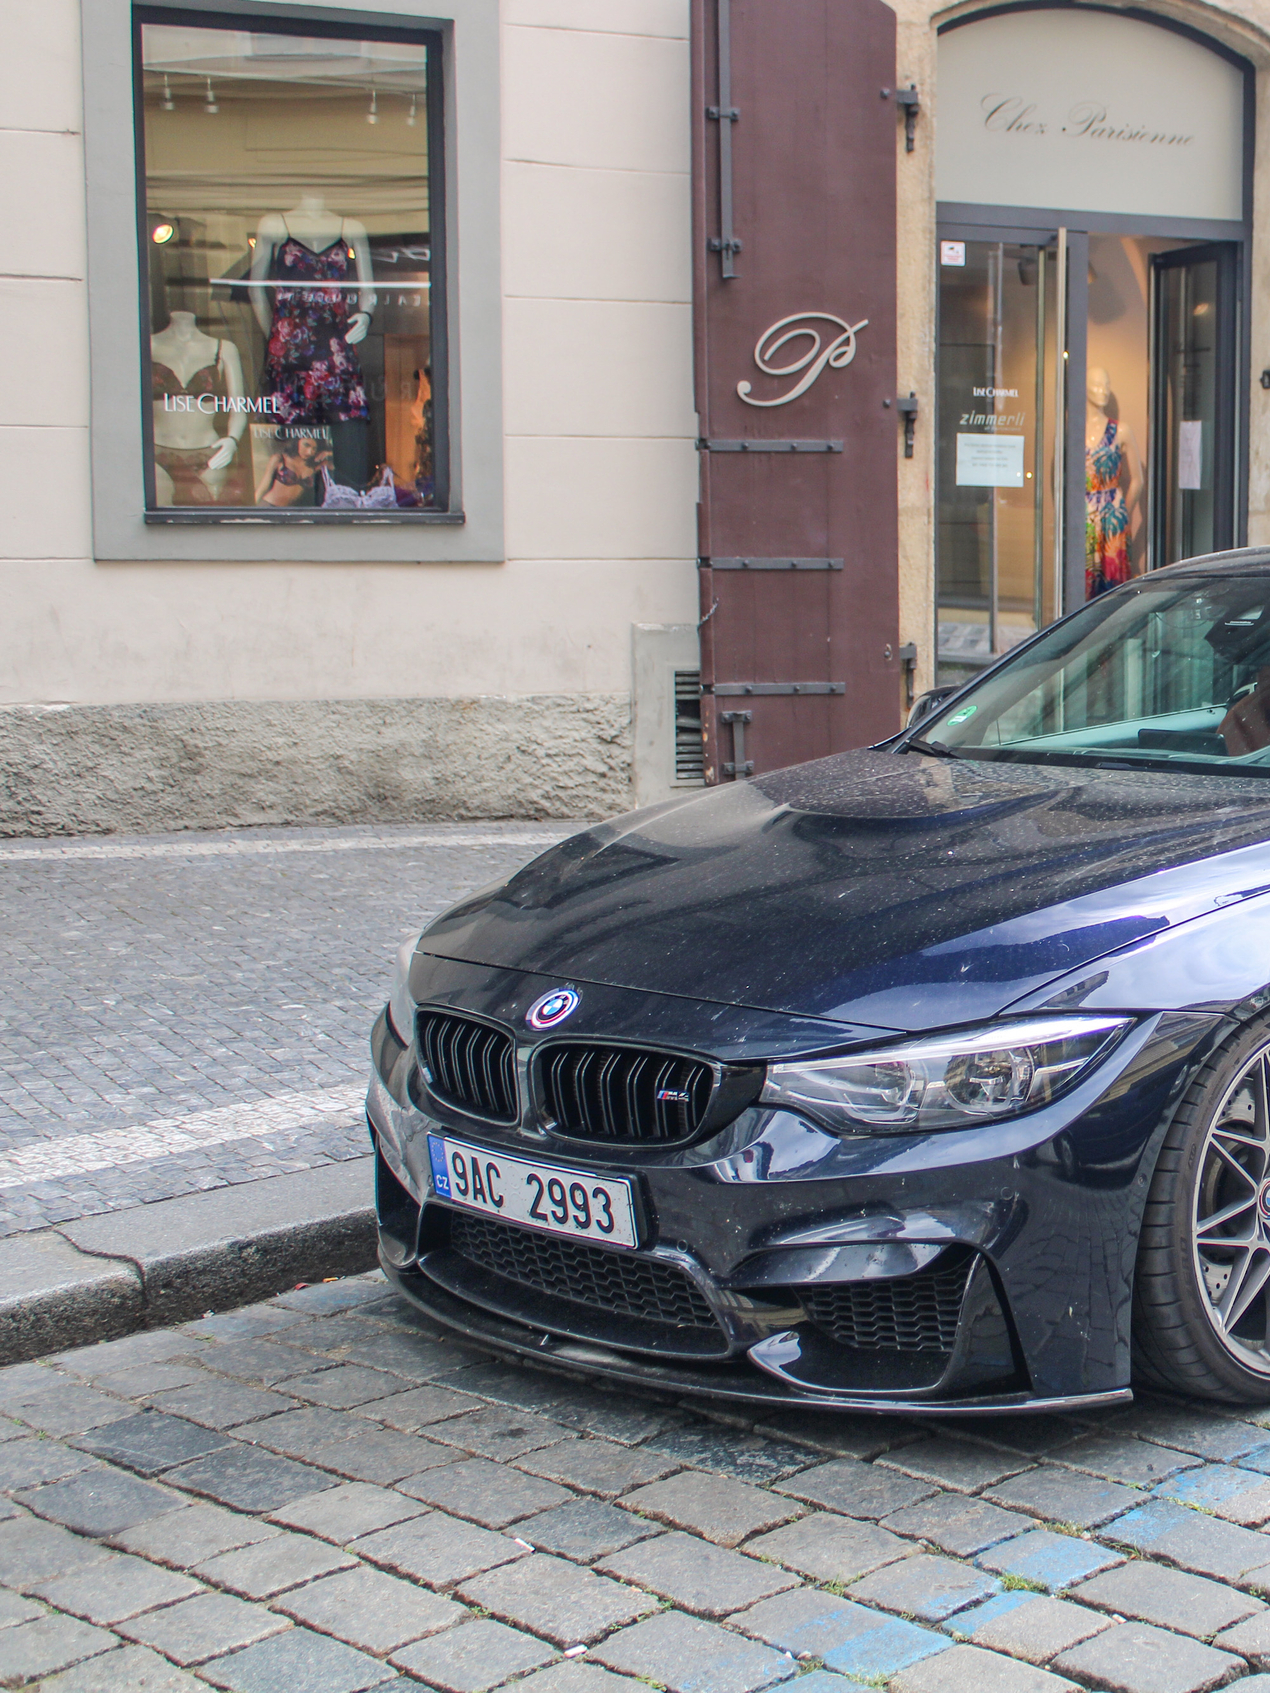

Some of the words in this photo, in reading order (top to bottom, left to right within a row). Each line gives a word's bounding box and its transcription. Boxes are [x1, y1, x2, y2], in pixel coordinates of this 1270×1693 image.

[980, 93, 1049, 136] Chez
[1061, 101, 1195, 146] Parisienne
[164, 392, 196, 413] LISE
[197, 393, 283, 415] CHARMEL
[959, 410, 1026, 427] zimmerli
[436, 1174, 450, 1190] CZ
[452, 1151, 504, 1208] 9AC
[526, 1172, 615, 1235] 2993
